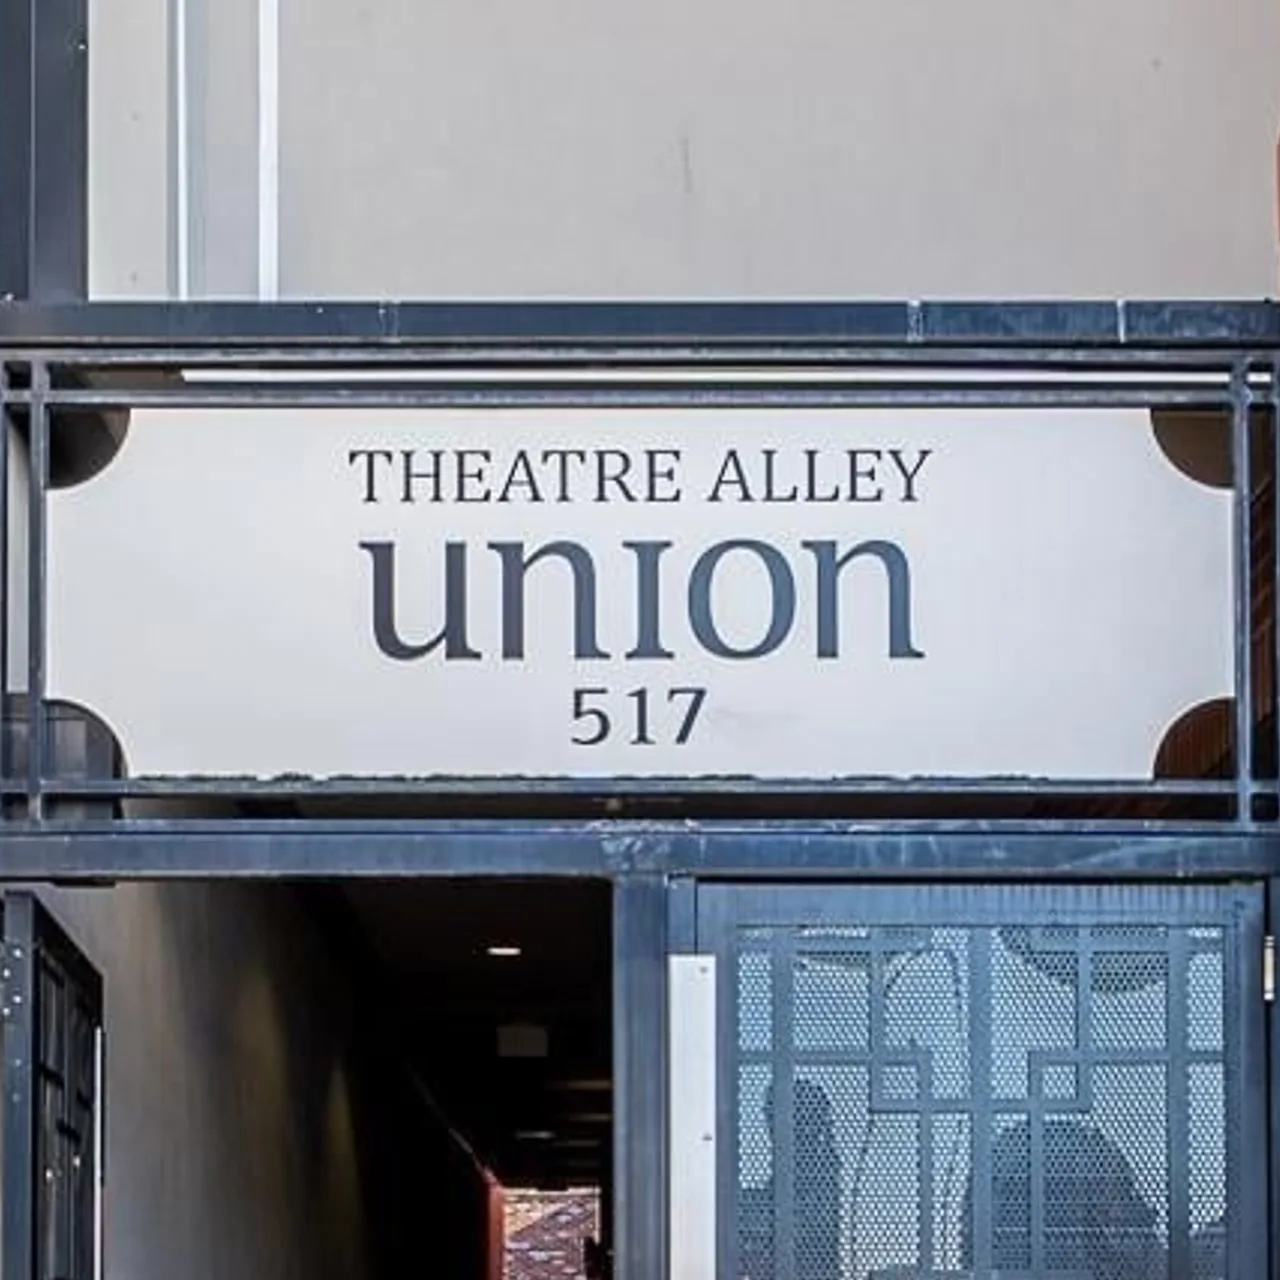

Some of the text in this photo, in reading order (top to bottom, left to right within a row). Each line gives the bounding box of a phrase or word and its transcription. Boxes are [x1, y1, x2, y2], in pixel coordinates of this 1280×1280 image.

[348, 449, 933, 502] THEATRE ALLEY
[570, 687, 707, 746] 517
